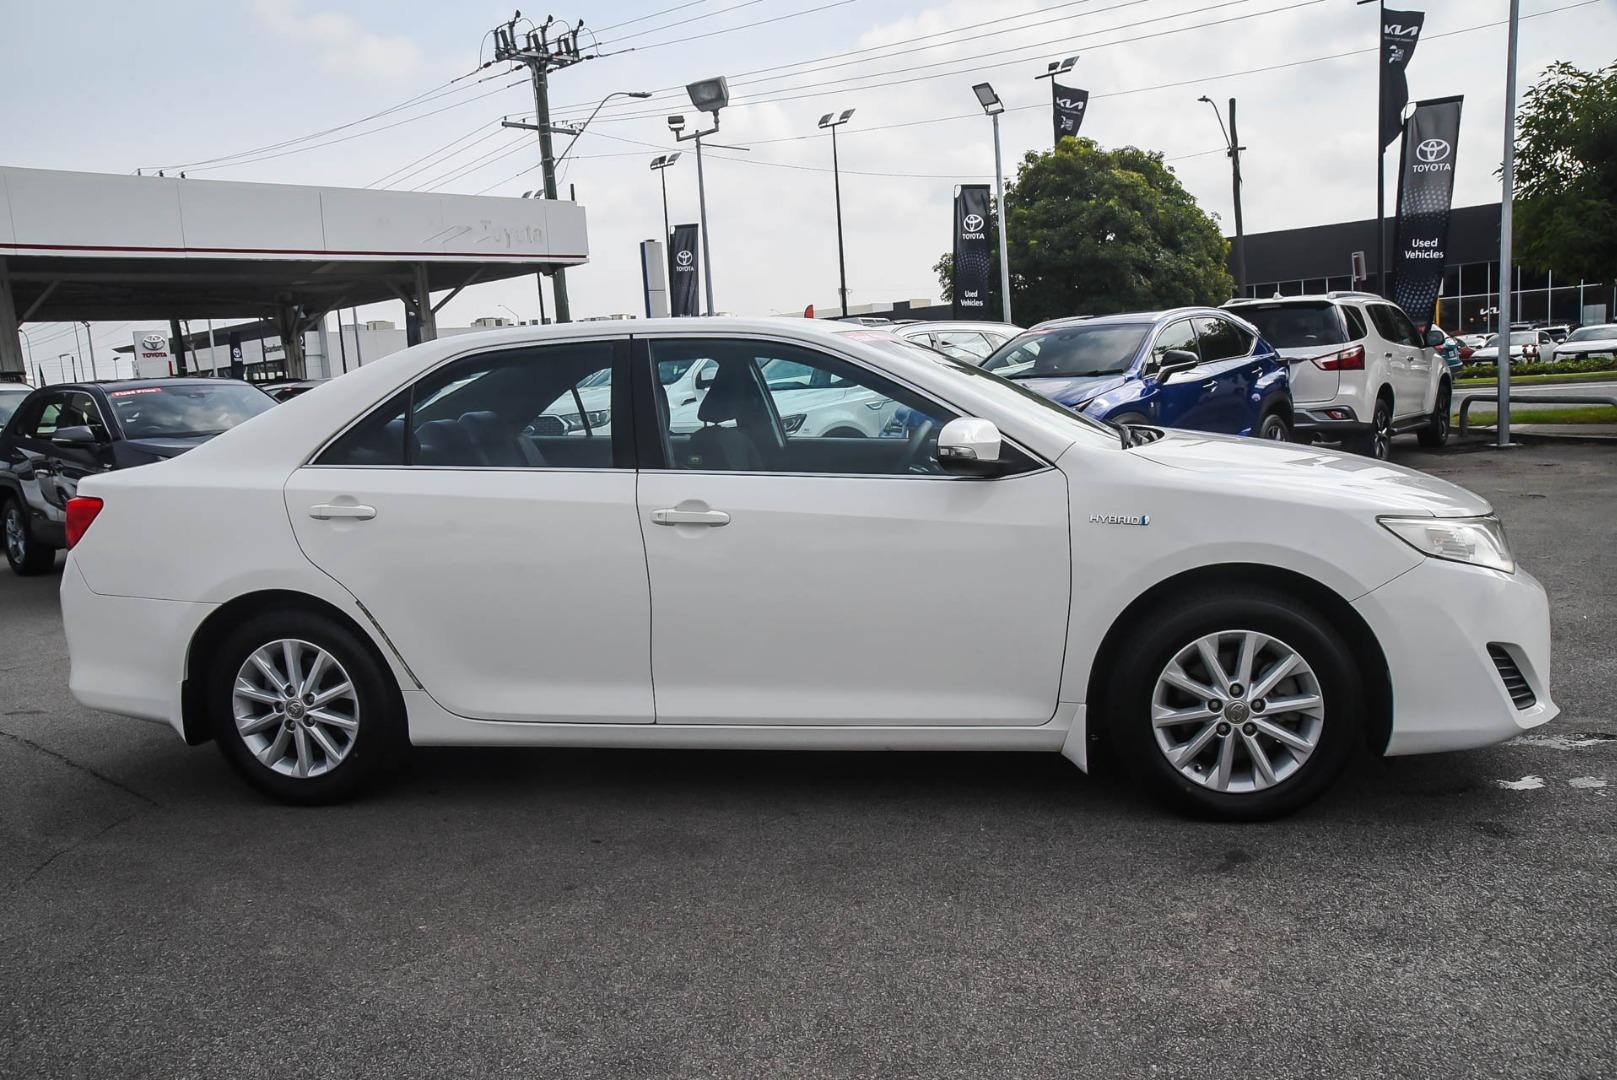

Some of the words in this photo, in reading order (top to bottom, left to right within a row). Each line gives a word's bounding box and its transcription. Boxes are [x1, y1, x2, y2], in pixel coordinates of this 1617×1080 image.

[1412, 163, 1451, 173] TOYOTA
[1412, 238, 1438, 248] Used
[1405, 249, 1444, 259] Vehicles
[964, 290, 978, 298] Used
[960, 299, 984, 307] Vehicles
[1089, 514, 1140, 526] HYBRID
